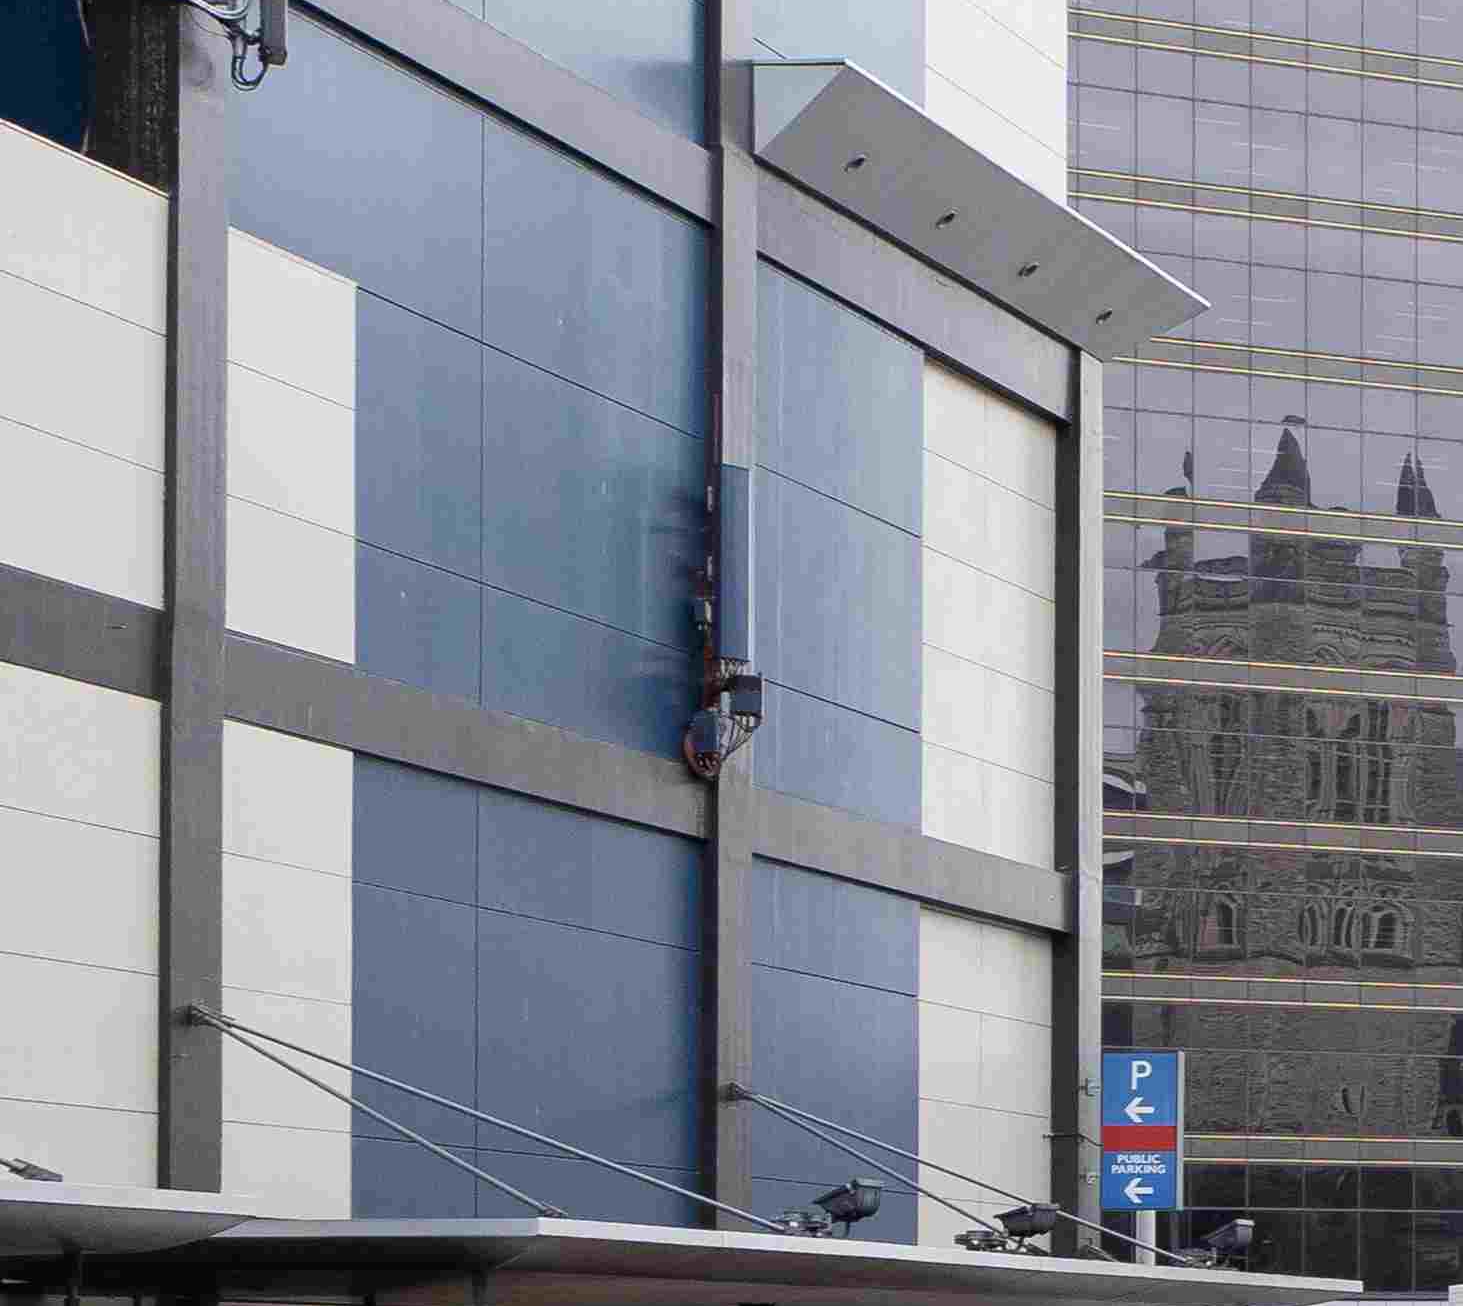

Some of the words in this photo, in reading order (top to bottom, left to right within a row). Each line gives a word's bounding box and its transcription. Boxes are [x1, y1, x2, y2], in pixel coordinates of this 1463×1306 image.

[1131, 1060, 1153, 1091] P
[1116, 1154, 1161, 1164] PUBLIC
[1111, 1164, 1166, 1175] PARKING
